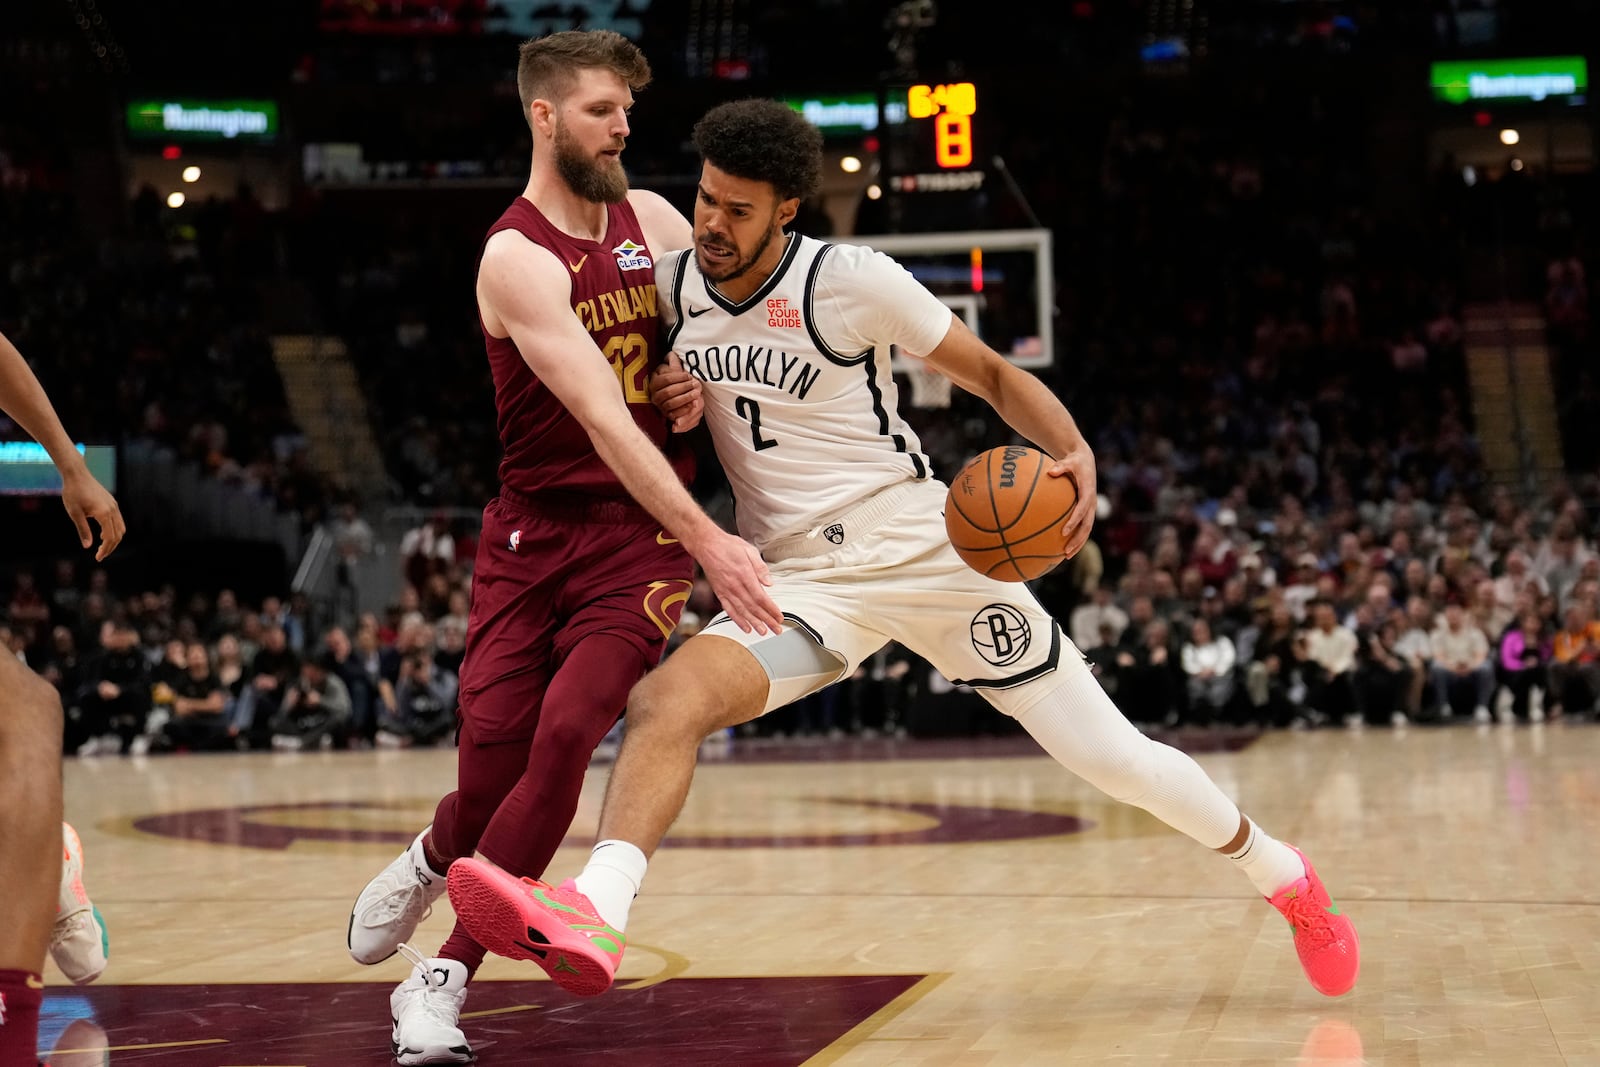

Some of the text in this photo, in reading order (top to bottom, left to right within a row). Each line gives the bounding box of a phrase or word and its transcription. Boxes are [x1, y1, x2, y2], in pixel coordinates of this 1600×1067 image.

[934, 113, 973, 169] 8
[619, 258, 650, 268] CLIFFS
[767, 299, 788, 308] GET
[768, 309, 799, 318] YOUR
[768, 318, 801, 328] GUIDE
[681, 345, 821, 400] ROOKLYN
[735, 395, 778, 451] 2
